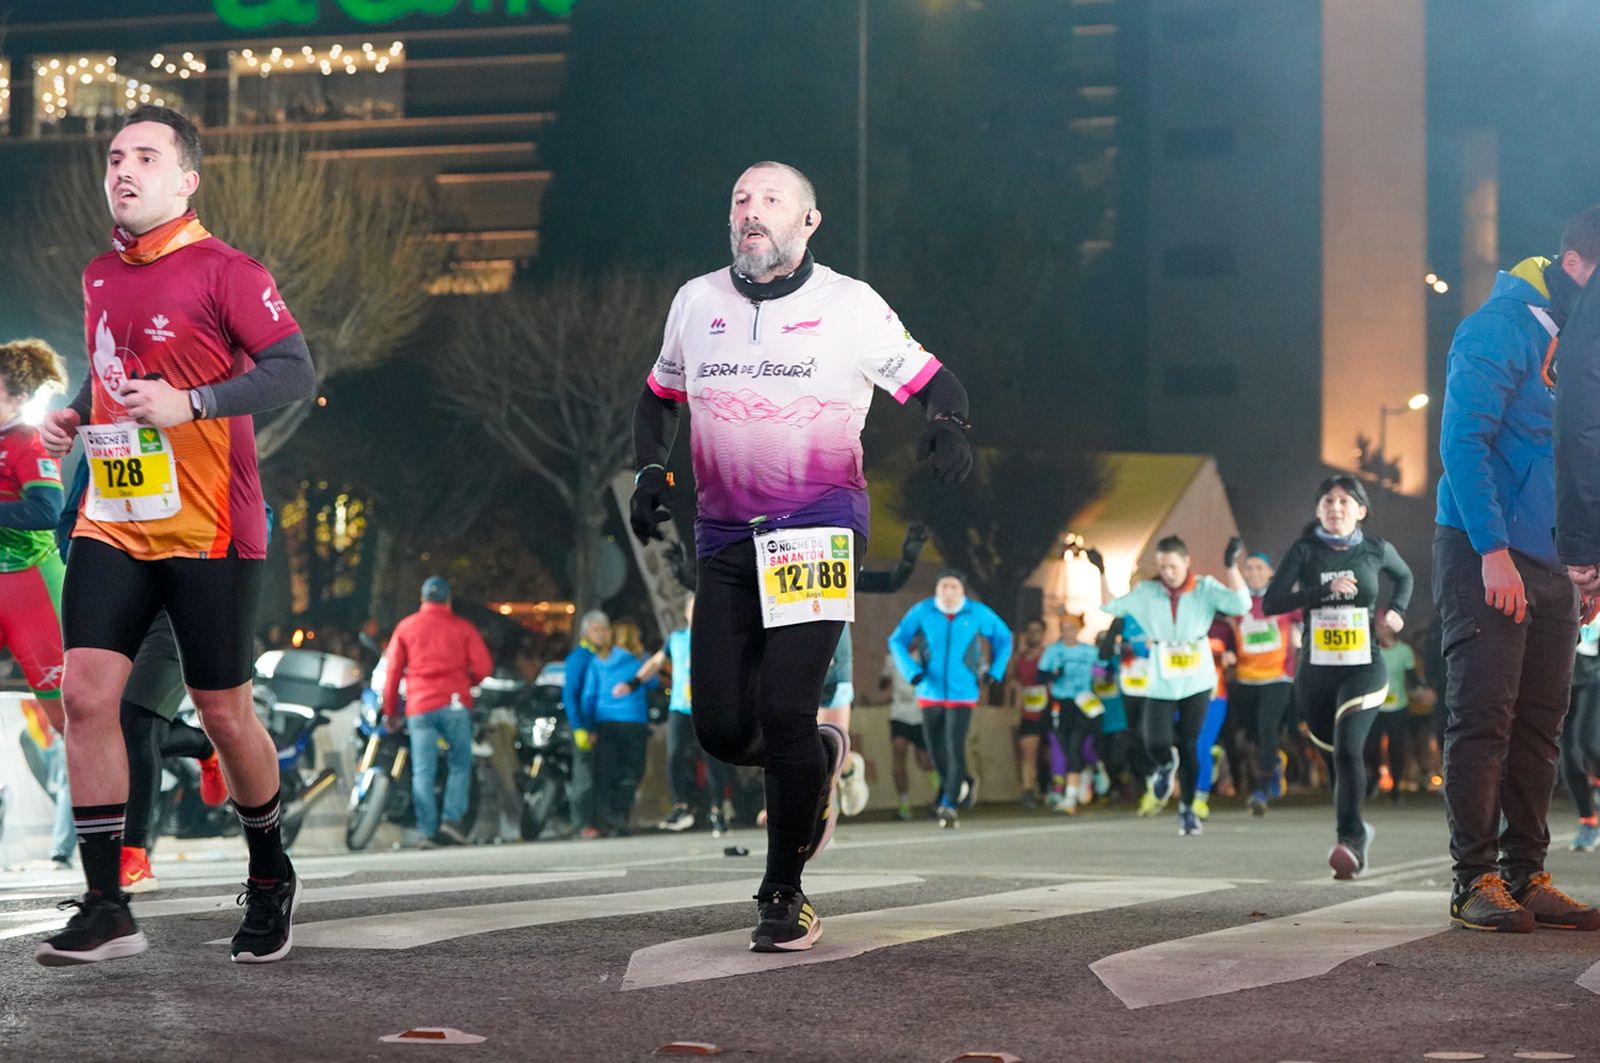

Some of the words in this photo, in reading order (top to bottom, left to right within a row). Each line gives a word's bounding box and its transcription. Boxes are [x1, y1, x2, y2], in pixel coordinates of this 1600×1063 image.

[692, 362, 739, 382] SERRA
[740, 364, 755, 374] DE
[752, 360, 812, 378] SEGURA
[770, 554, 788, 566] SAN
[774, 561, 847, 593] 12788
[1323, 630, 1357, 645] 9511
